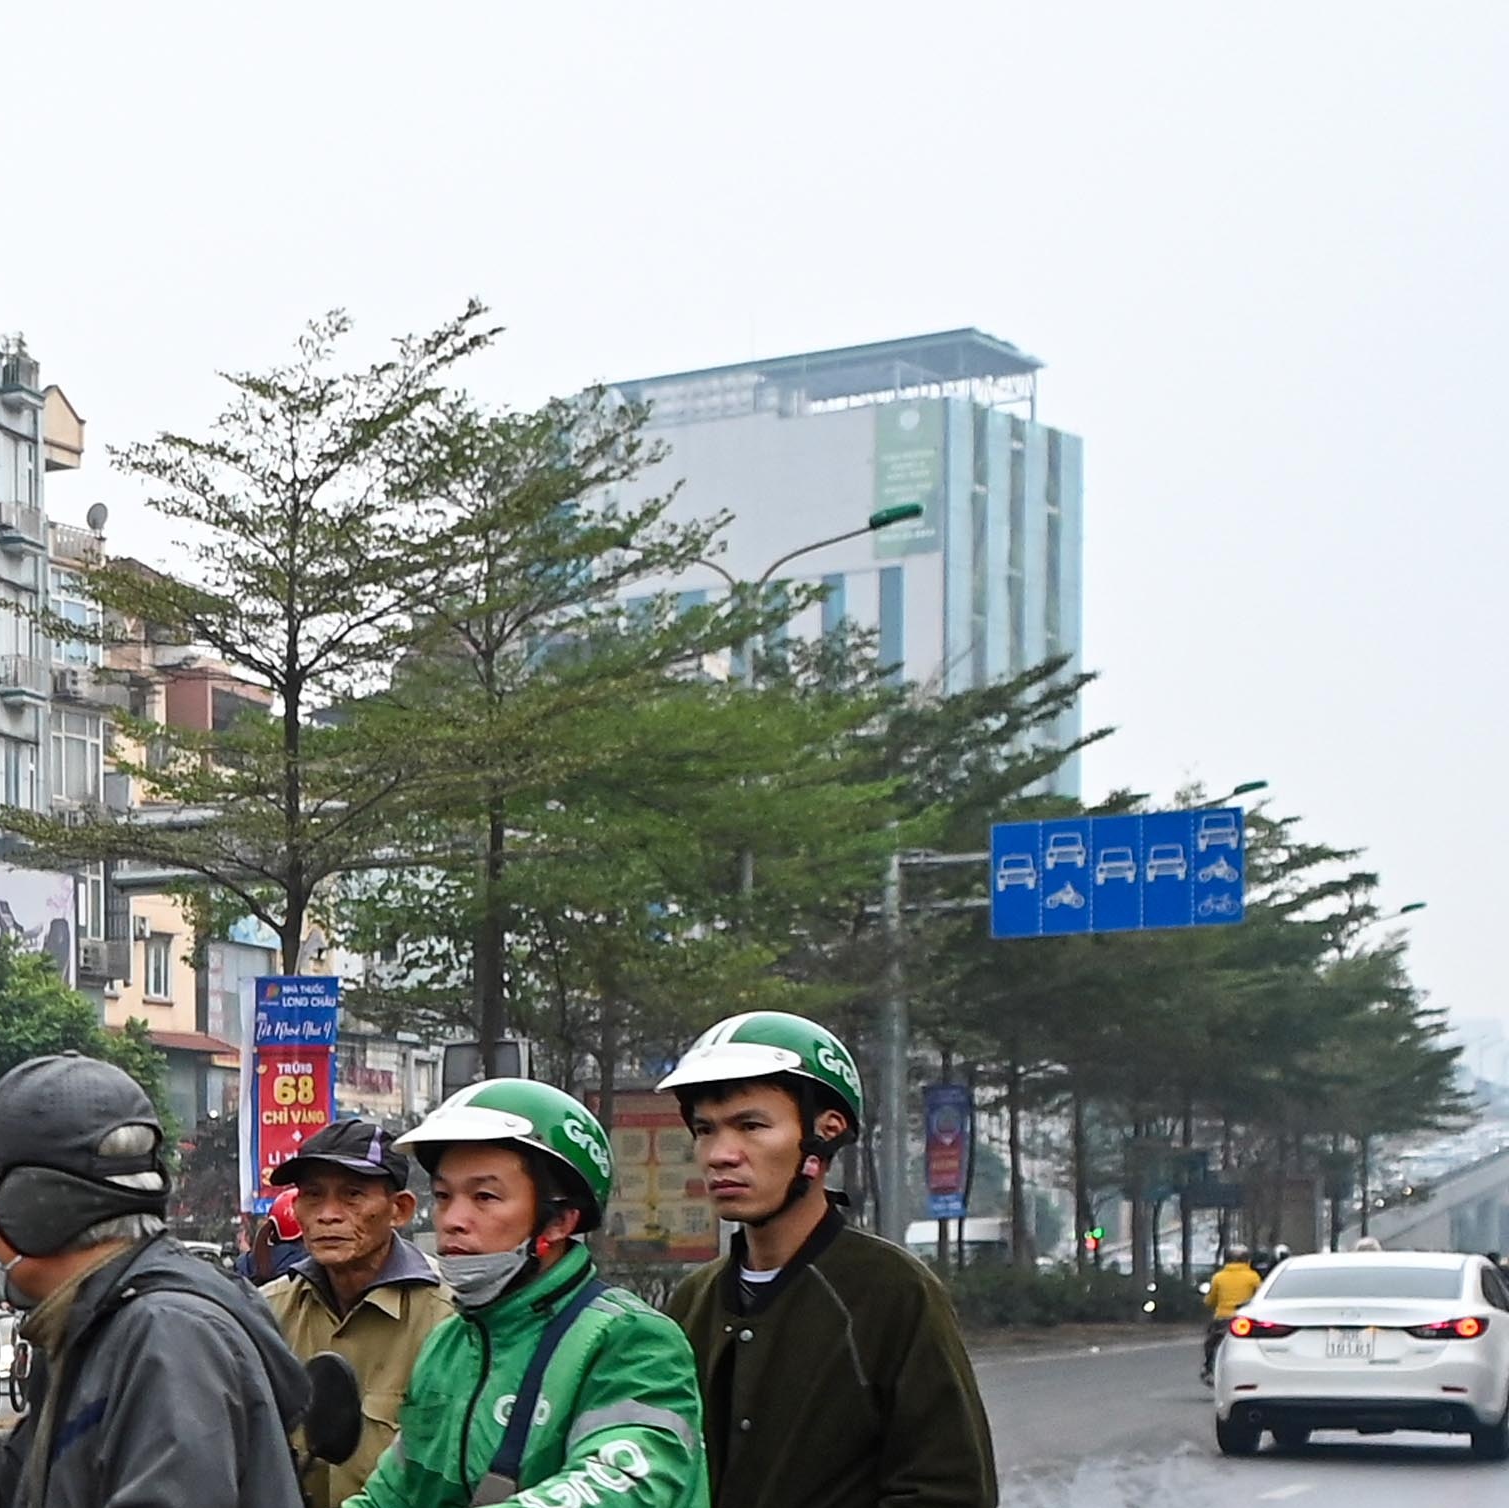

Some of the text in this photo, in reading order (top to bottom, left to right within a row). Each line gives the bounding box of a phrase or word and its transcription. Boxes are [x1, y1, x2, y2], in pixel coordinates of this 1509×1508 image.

[274, 1076, 315, 1105] 68
[292, 1107, 325, 1125] VÀNG
[563, 1118, 611, 1180] Grab
